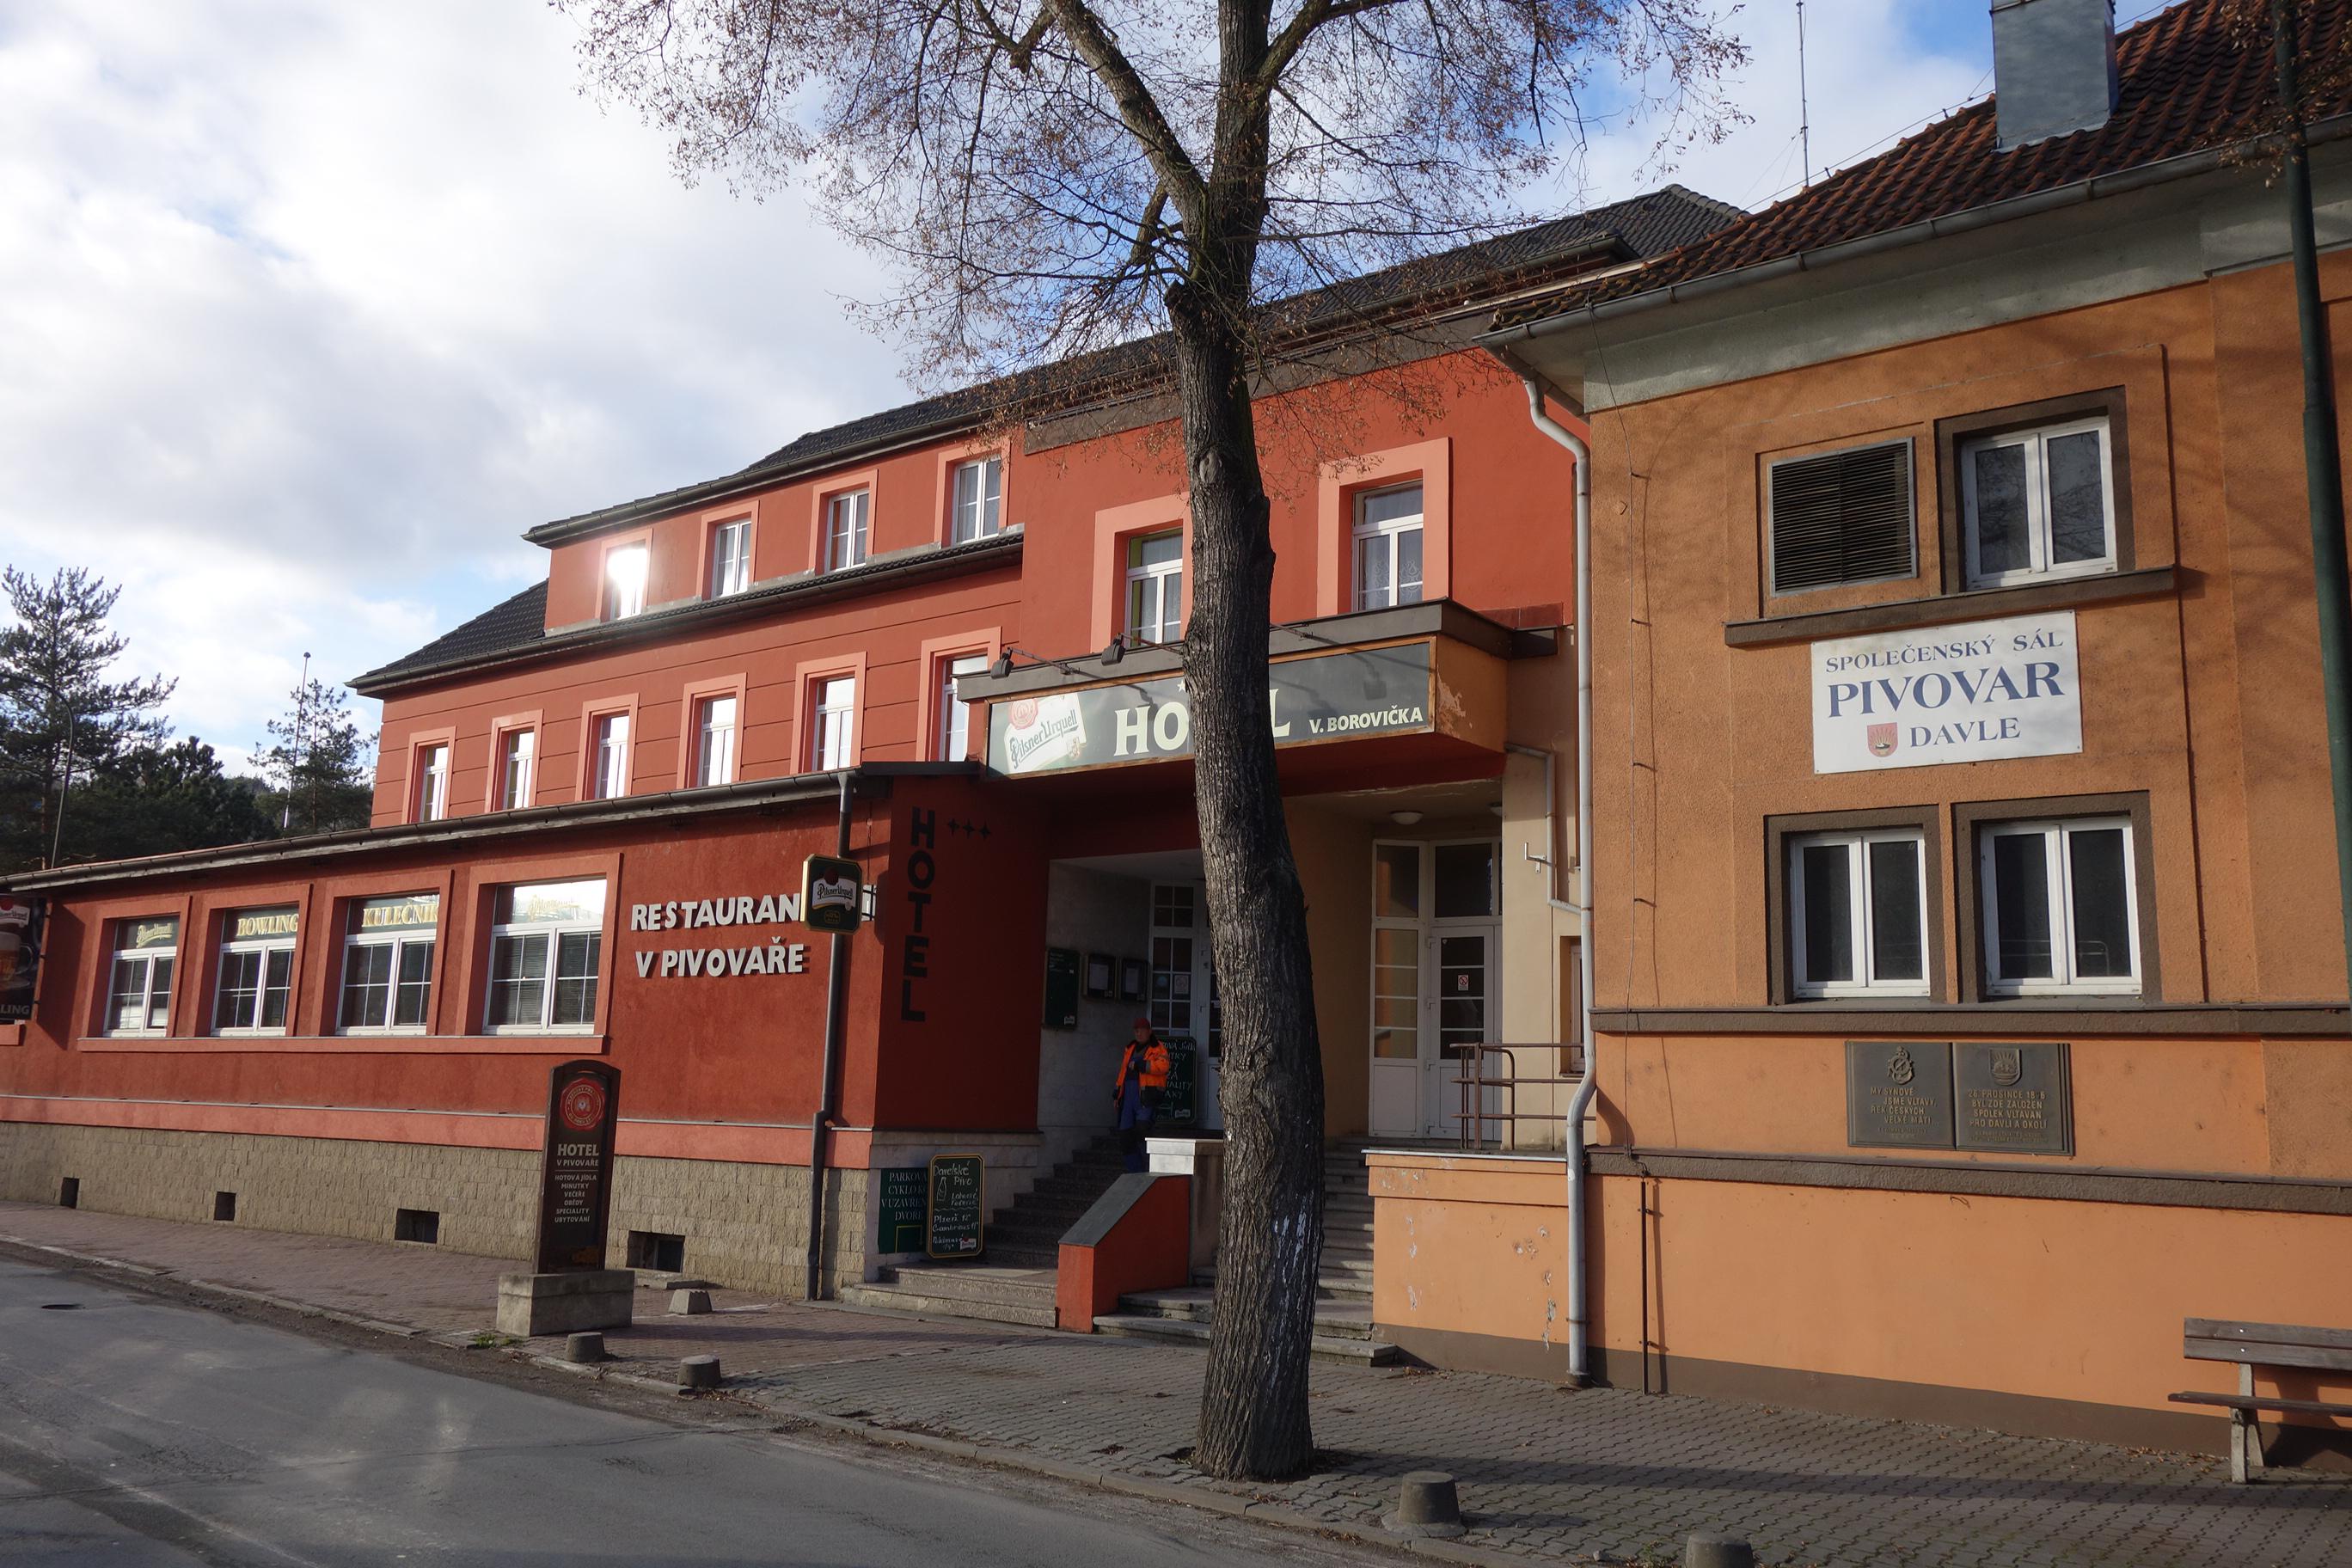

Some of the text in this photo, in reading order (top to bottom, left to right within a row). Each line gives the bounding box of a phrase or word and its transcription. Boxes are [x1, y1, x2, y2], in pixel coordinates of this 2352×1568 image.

[1825, 628, 2065, 674] SPOLEČENSKÝ SÁL
[1828, 661, 2066, 719] PIVOVAR
[1113, 688, 1291, 756] HOL
[1309, 705, 1424, 734] V. BOROVIČKA
[1909, 717, 2021, 748] DAVLE
[1009, 708, 1079, 769] Pilsner Urquell
[236, 913, 299, 937] BOWLING
[361, 901, 438, 928] KULEČNIK
[630, 891, 801, 932] RESTAURAN
[901, 805, 936, 1023] HOTEL
[635, 935, 805, 978] V PIVOVAŘE
[1981, 1089, 2024, 1099] PROSINCE
[1988, 1100, 2004, 1109] ZDE
[1973, 1109, 2004, 1118] SPOLEK
[2014, 1120, 2021, 1129] A
[557, 1143, 599, 1156] HOTEL
[563, 1157, 599, 1167] PIVOVAŘE
